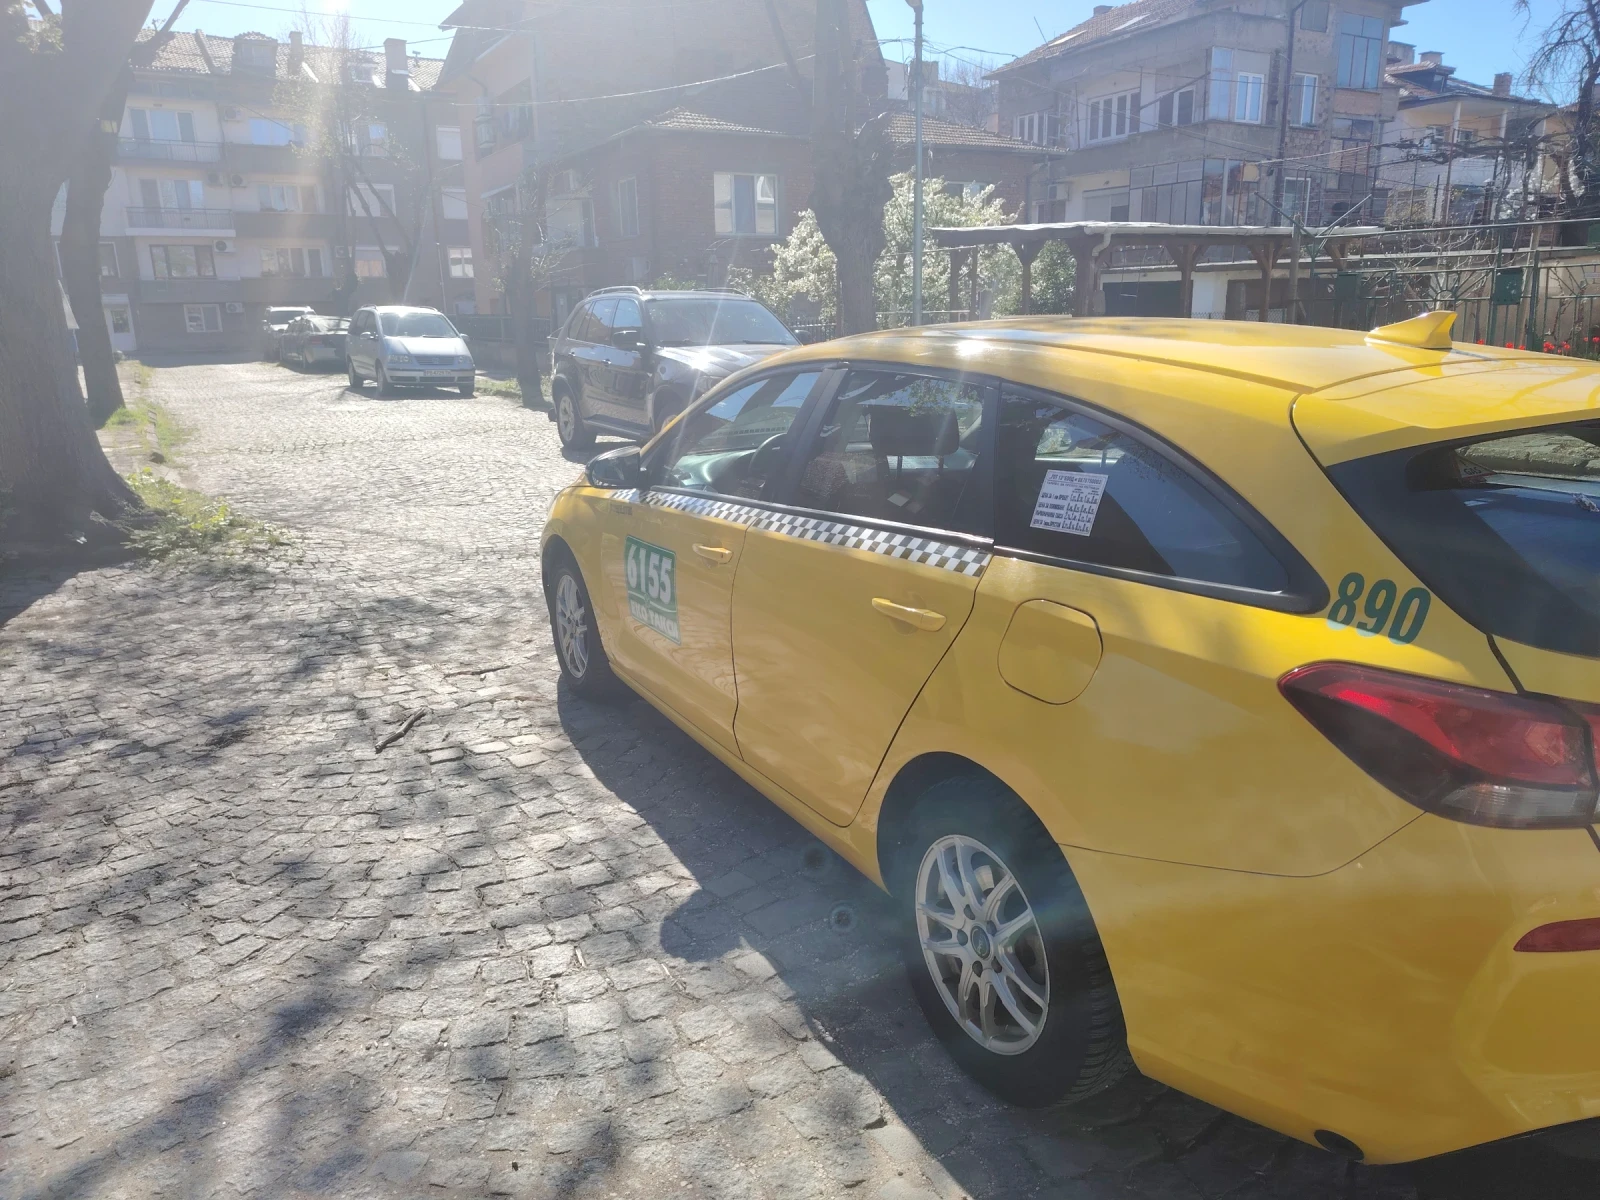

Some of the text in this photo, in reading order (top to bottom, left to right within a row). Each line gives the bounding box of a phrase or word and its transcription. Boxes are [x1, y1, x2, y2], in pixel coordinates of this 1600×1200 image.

[1463, 466, 1482, 475] GAS
[627, 544, 672, 605] 6155
[1327, 572, 1431, 645] 890
